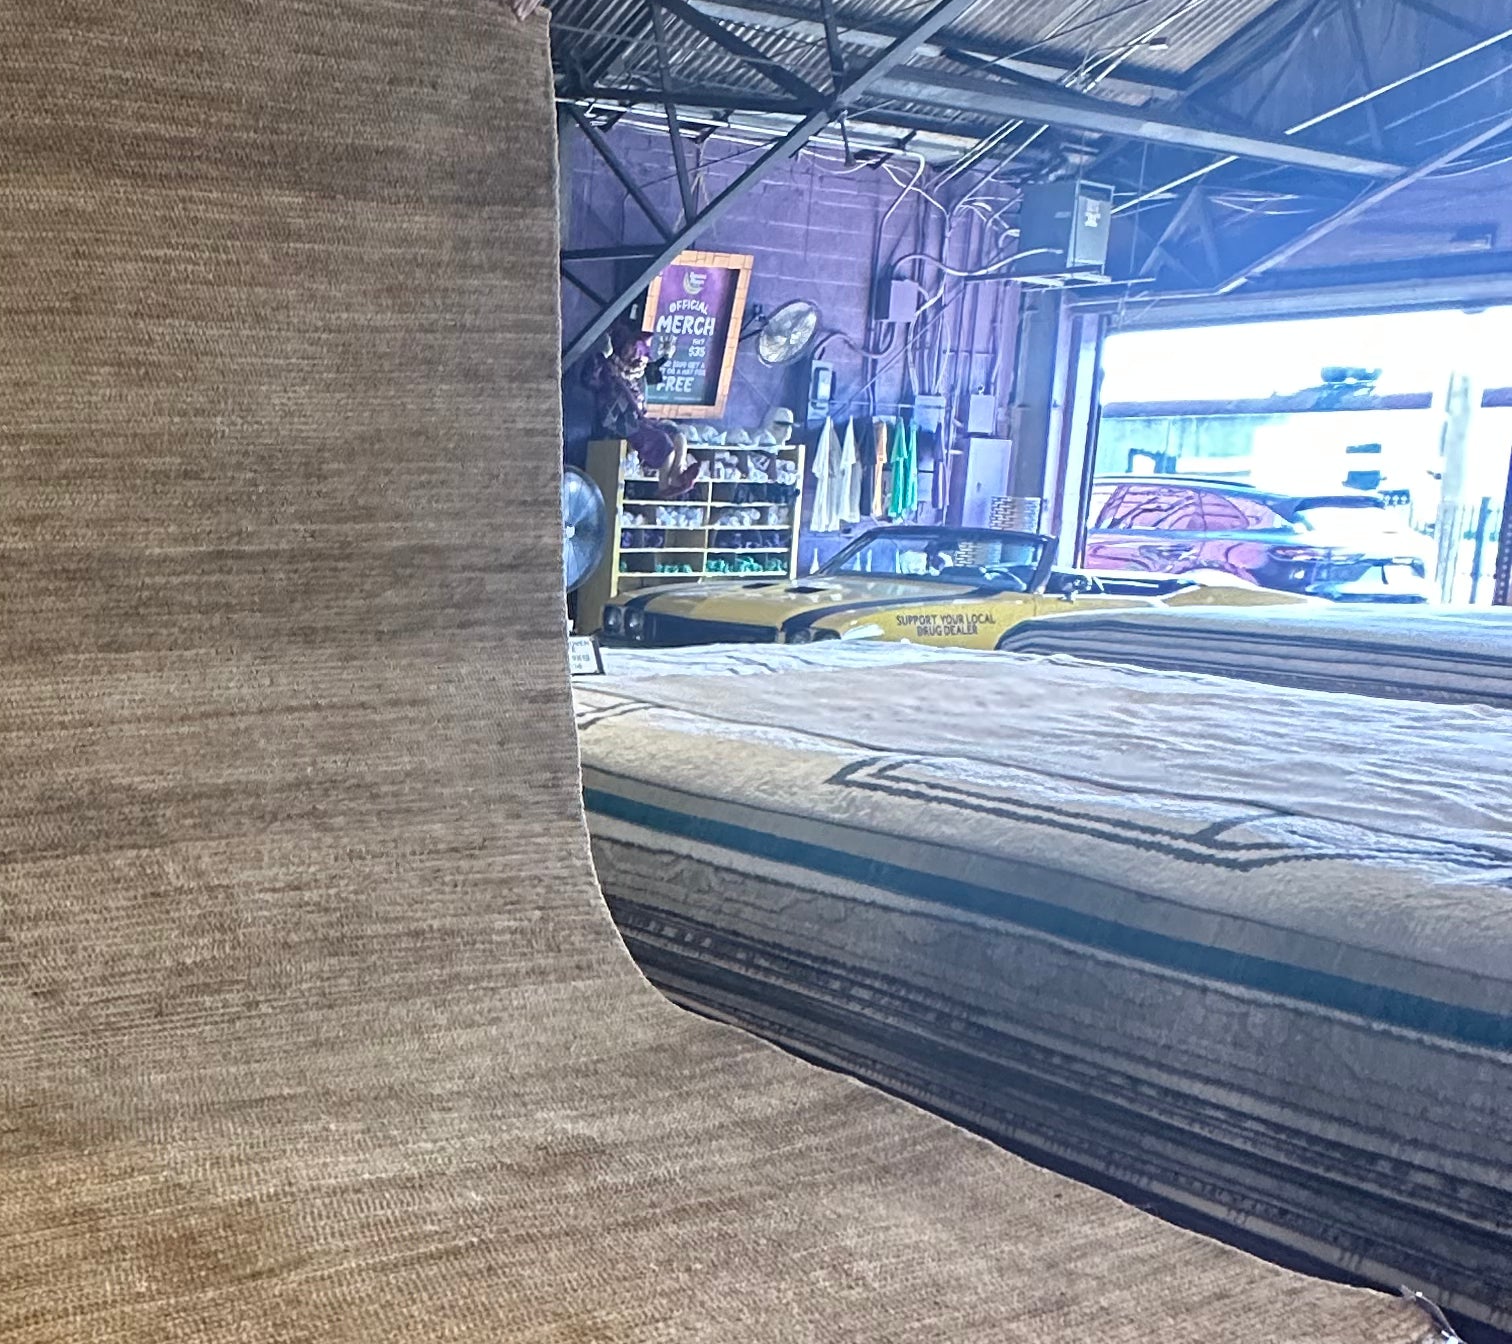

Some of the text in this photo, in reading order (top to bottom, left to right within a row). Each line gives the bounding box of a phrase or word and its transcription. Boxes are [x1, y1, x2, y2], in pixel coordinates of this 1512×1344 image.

[669, 299, 708, 315] OFFICIAL
[656, 315, 716, 336] MERCH
[688, 345, 706, 358] $35
[896, 613, 996, 626] SUPPORT YOUR LOCAL
[917, 624, 978, 637] DRUG DEALER
